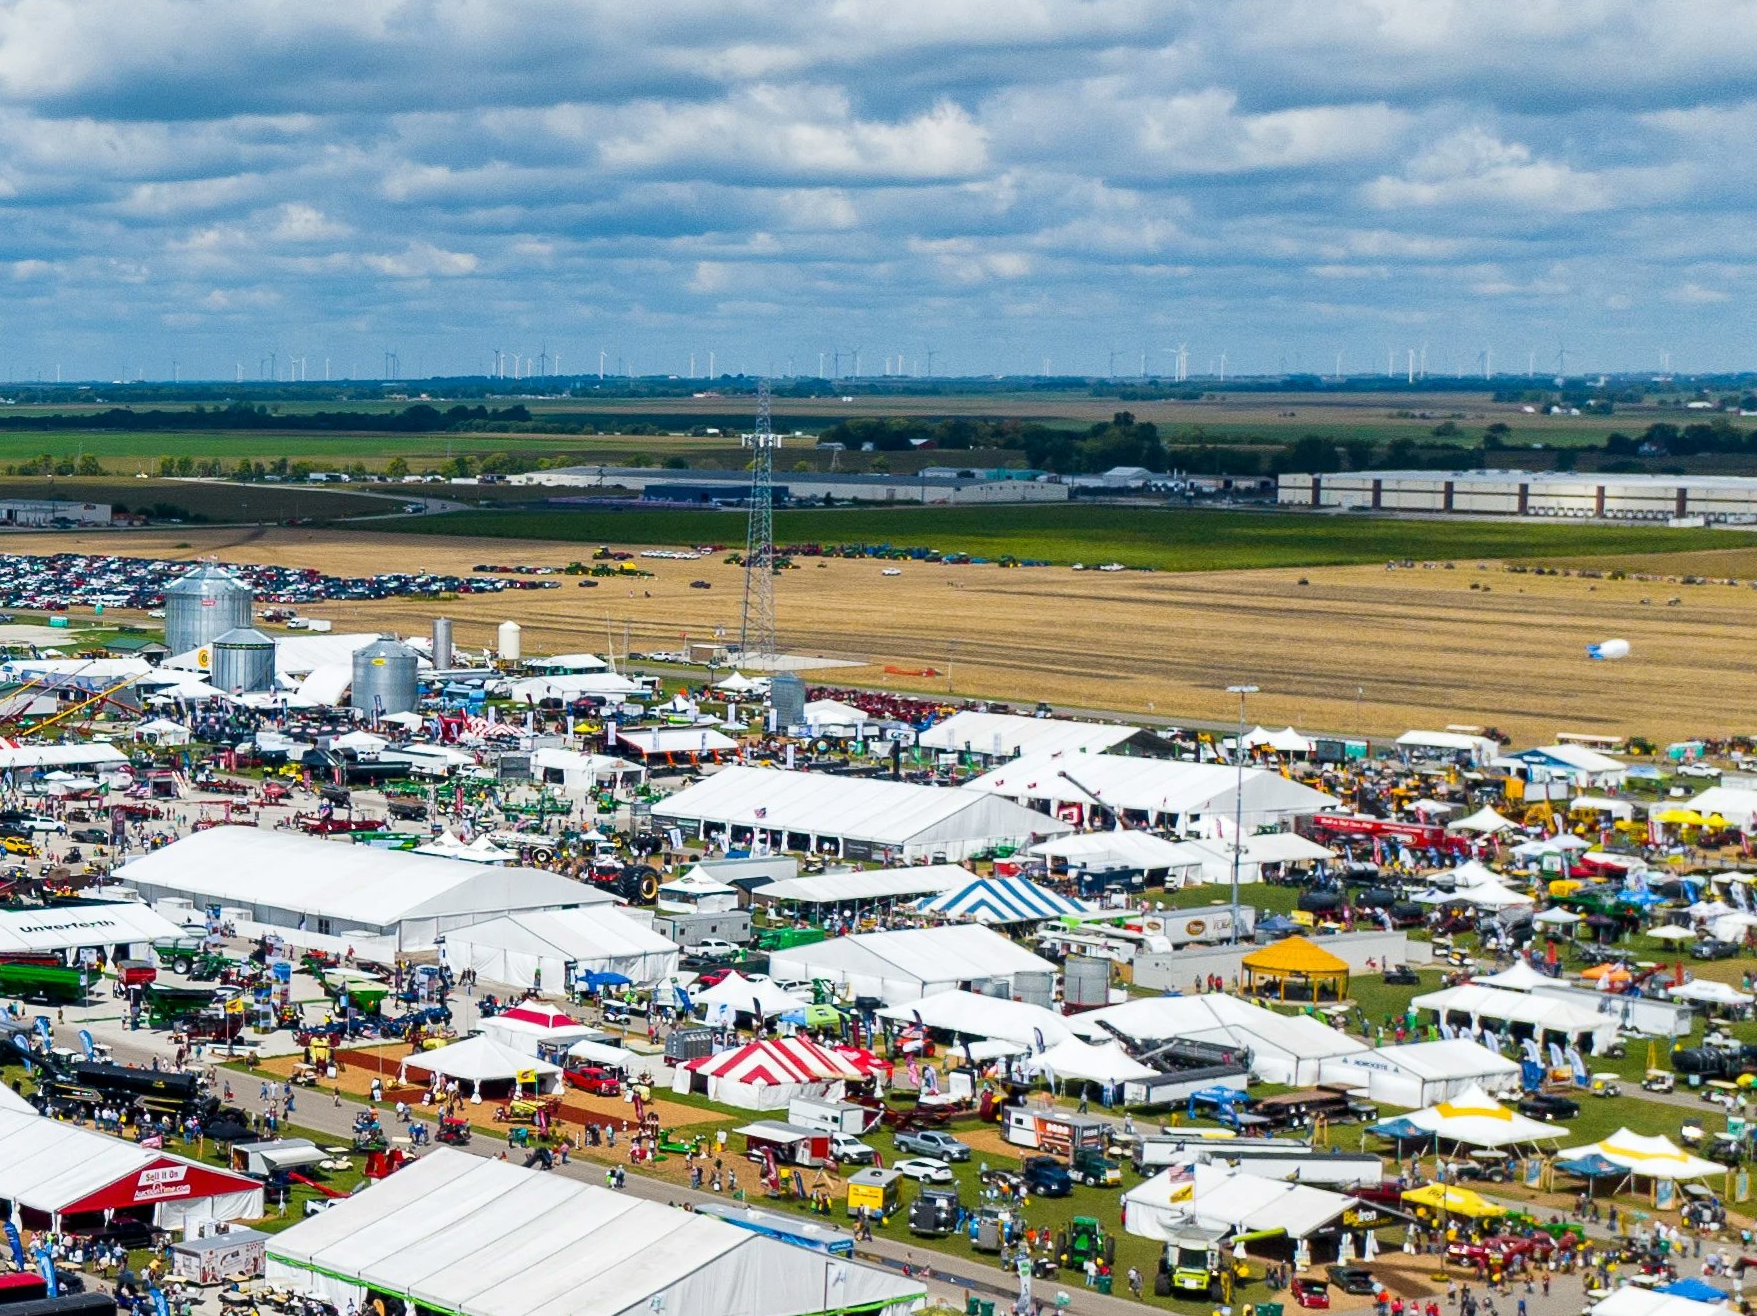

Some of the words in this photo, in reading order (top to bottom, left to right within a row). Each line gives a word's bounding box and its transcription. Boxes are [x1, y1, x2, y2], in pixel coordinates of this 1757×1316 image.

[19, 920, 116, 933] Unverferth
[146, 1172, 159, 1182] Sell
[169, 1170, 178, 1179] On
